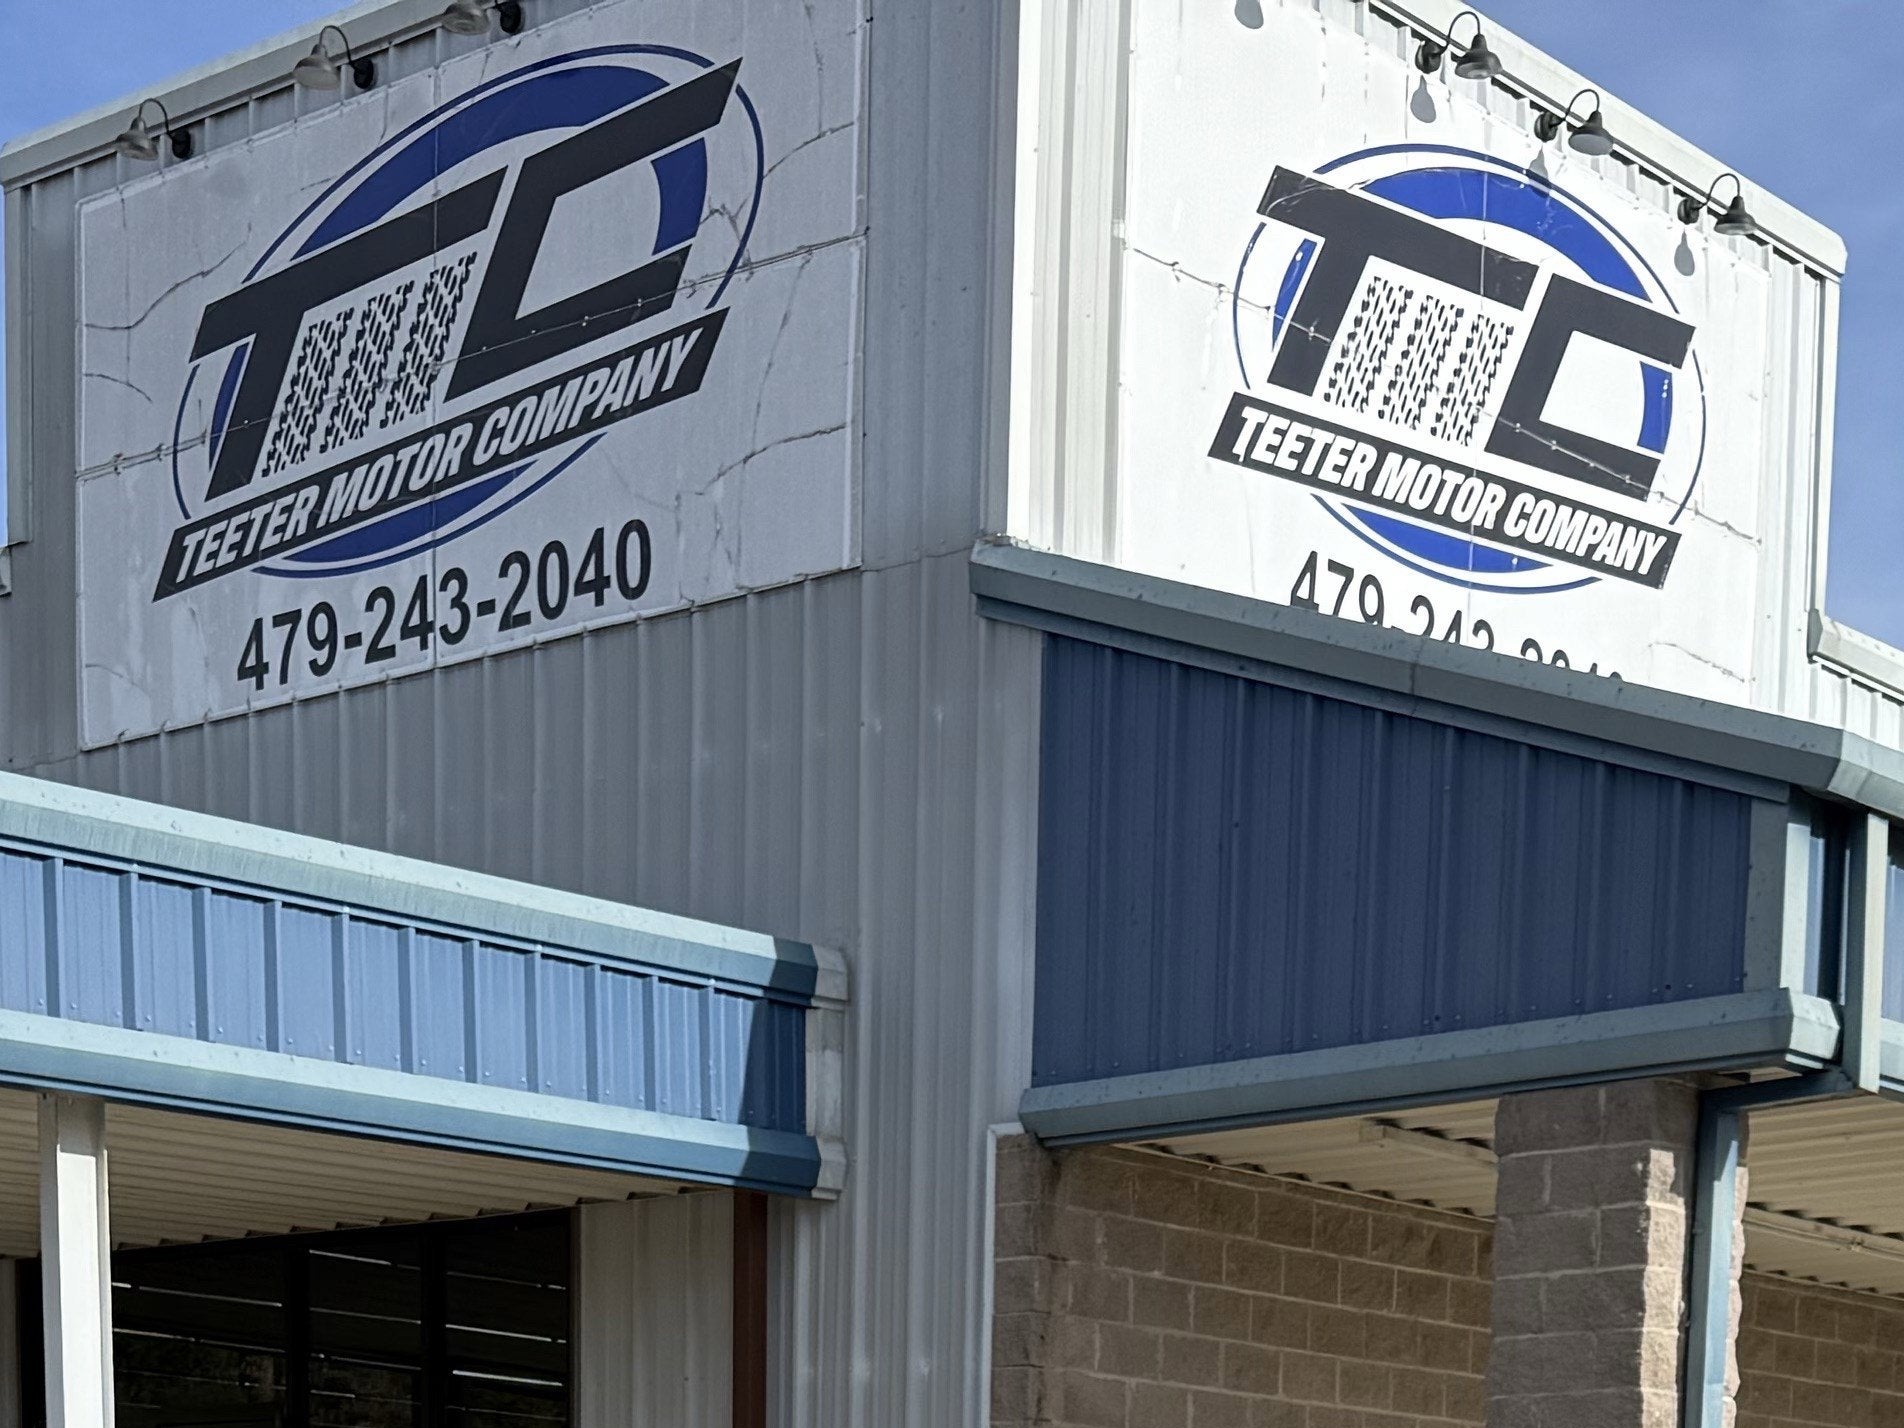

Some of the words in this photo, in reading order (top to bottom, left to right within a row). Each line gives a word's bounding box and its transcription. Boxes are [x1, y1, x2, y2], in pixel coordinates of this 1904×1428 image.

[177, 490, 314, 585] TEETER
[317, 432, 466, 532] MOTOR
[474, 327, 701, 469] COMPANY
[1239, 406, 1371, 493] TEETER
[1376, 455, 1506, 530] MOTOR
[1507, 492, 1667, 576] COMPANY
[237, 519, 652, 691] 479-243-2040
